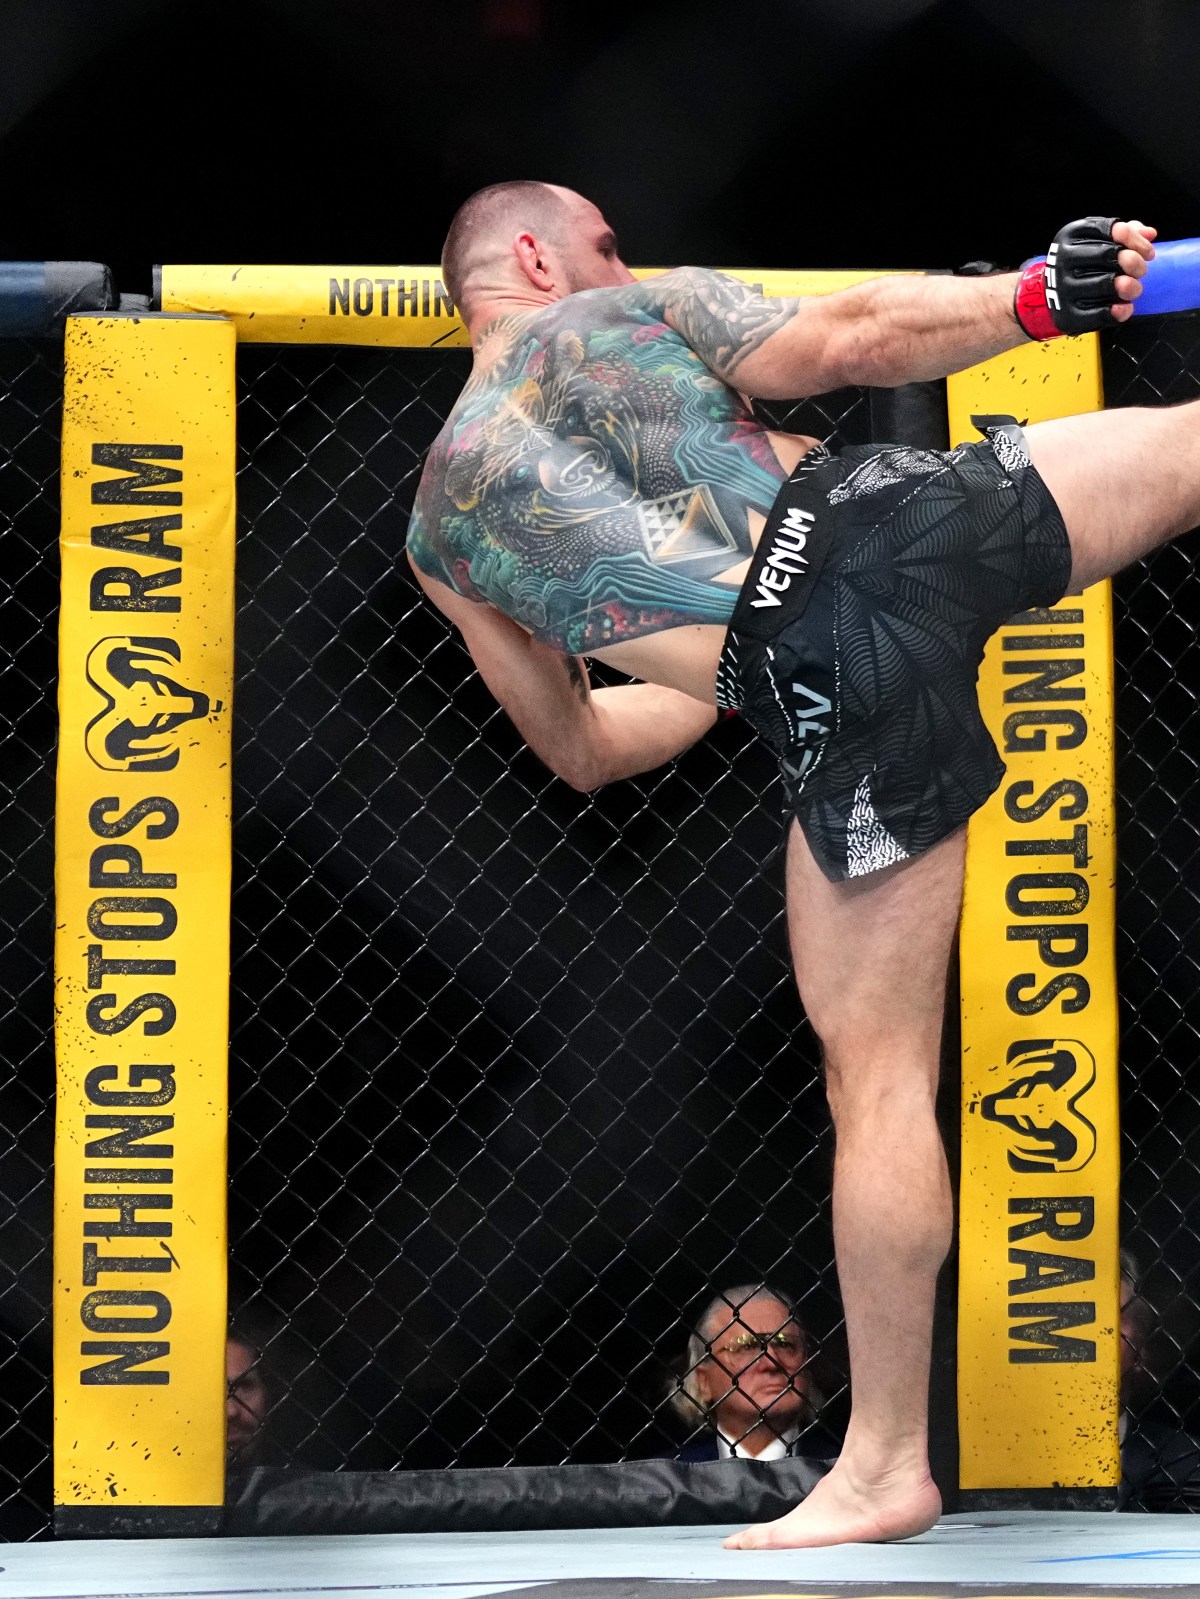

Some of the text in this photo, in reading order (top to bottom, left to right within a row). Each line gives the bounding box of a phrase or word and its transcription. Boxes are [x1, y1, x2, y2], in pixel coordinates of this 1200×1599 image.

[329, 278, 455, 317] NOTHIN
[750, 507, 816, 608] VENUM
[80, 443, 184, 1385] NOTHING STOPS RAM
[1004, 779, 1090, 1016] STOPS
[1008, 1196, 1096, 1364] RAM
